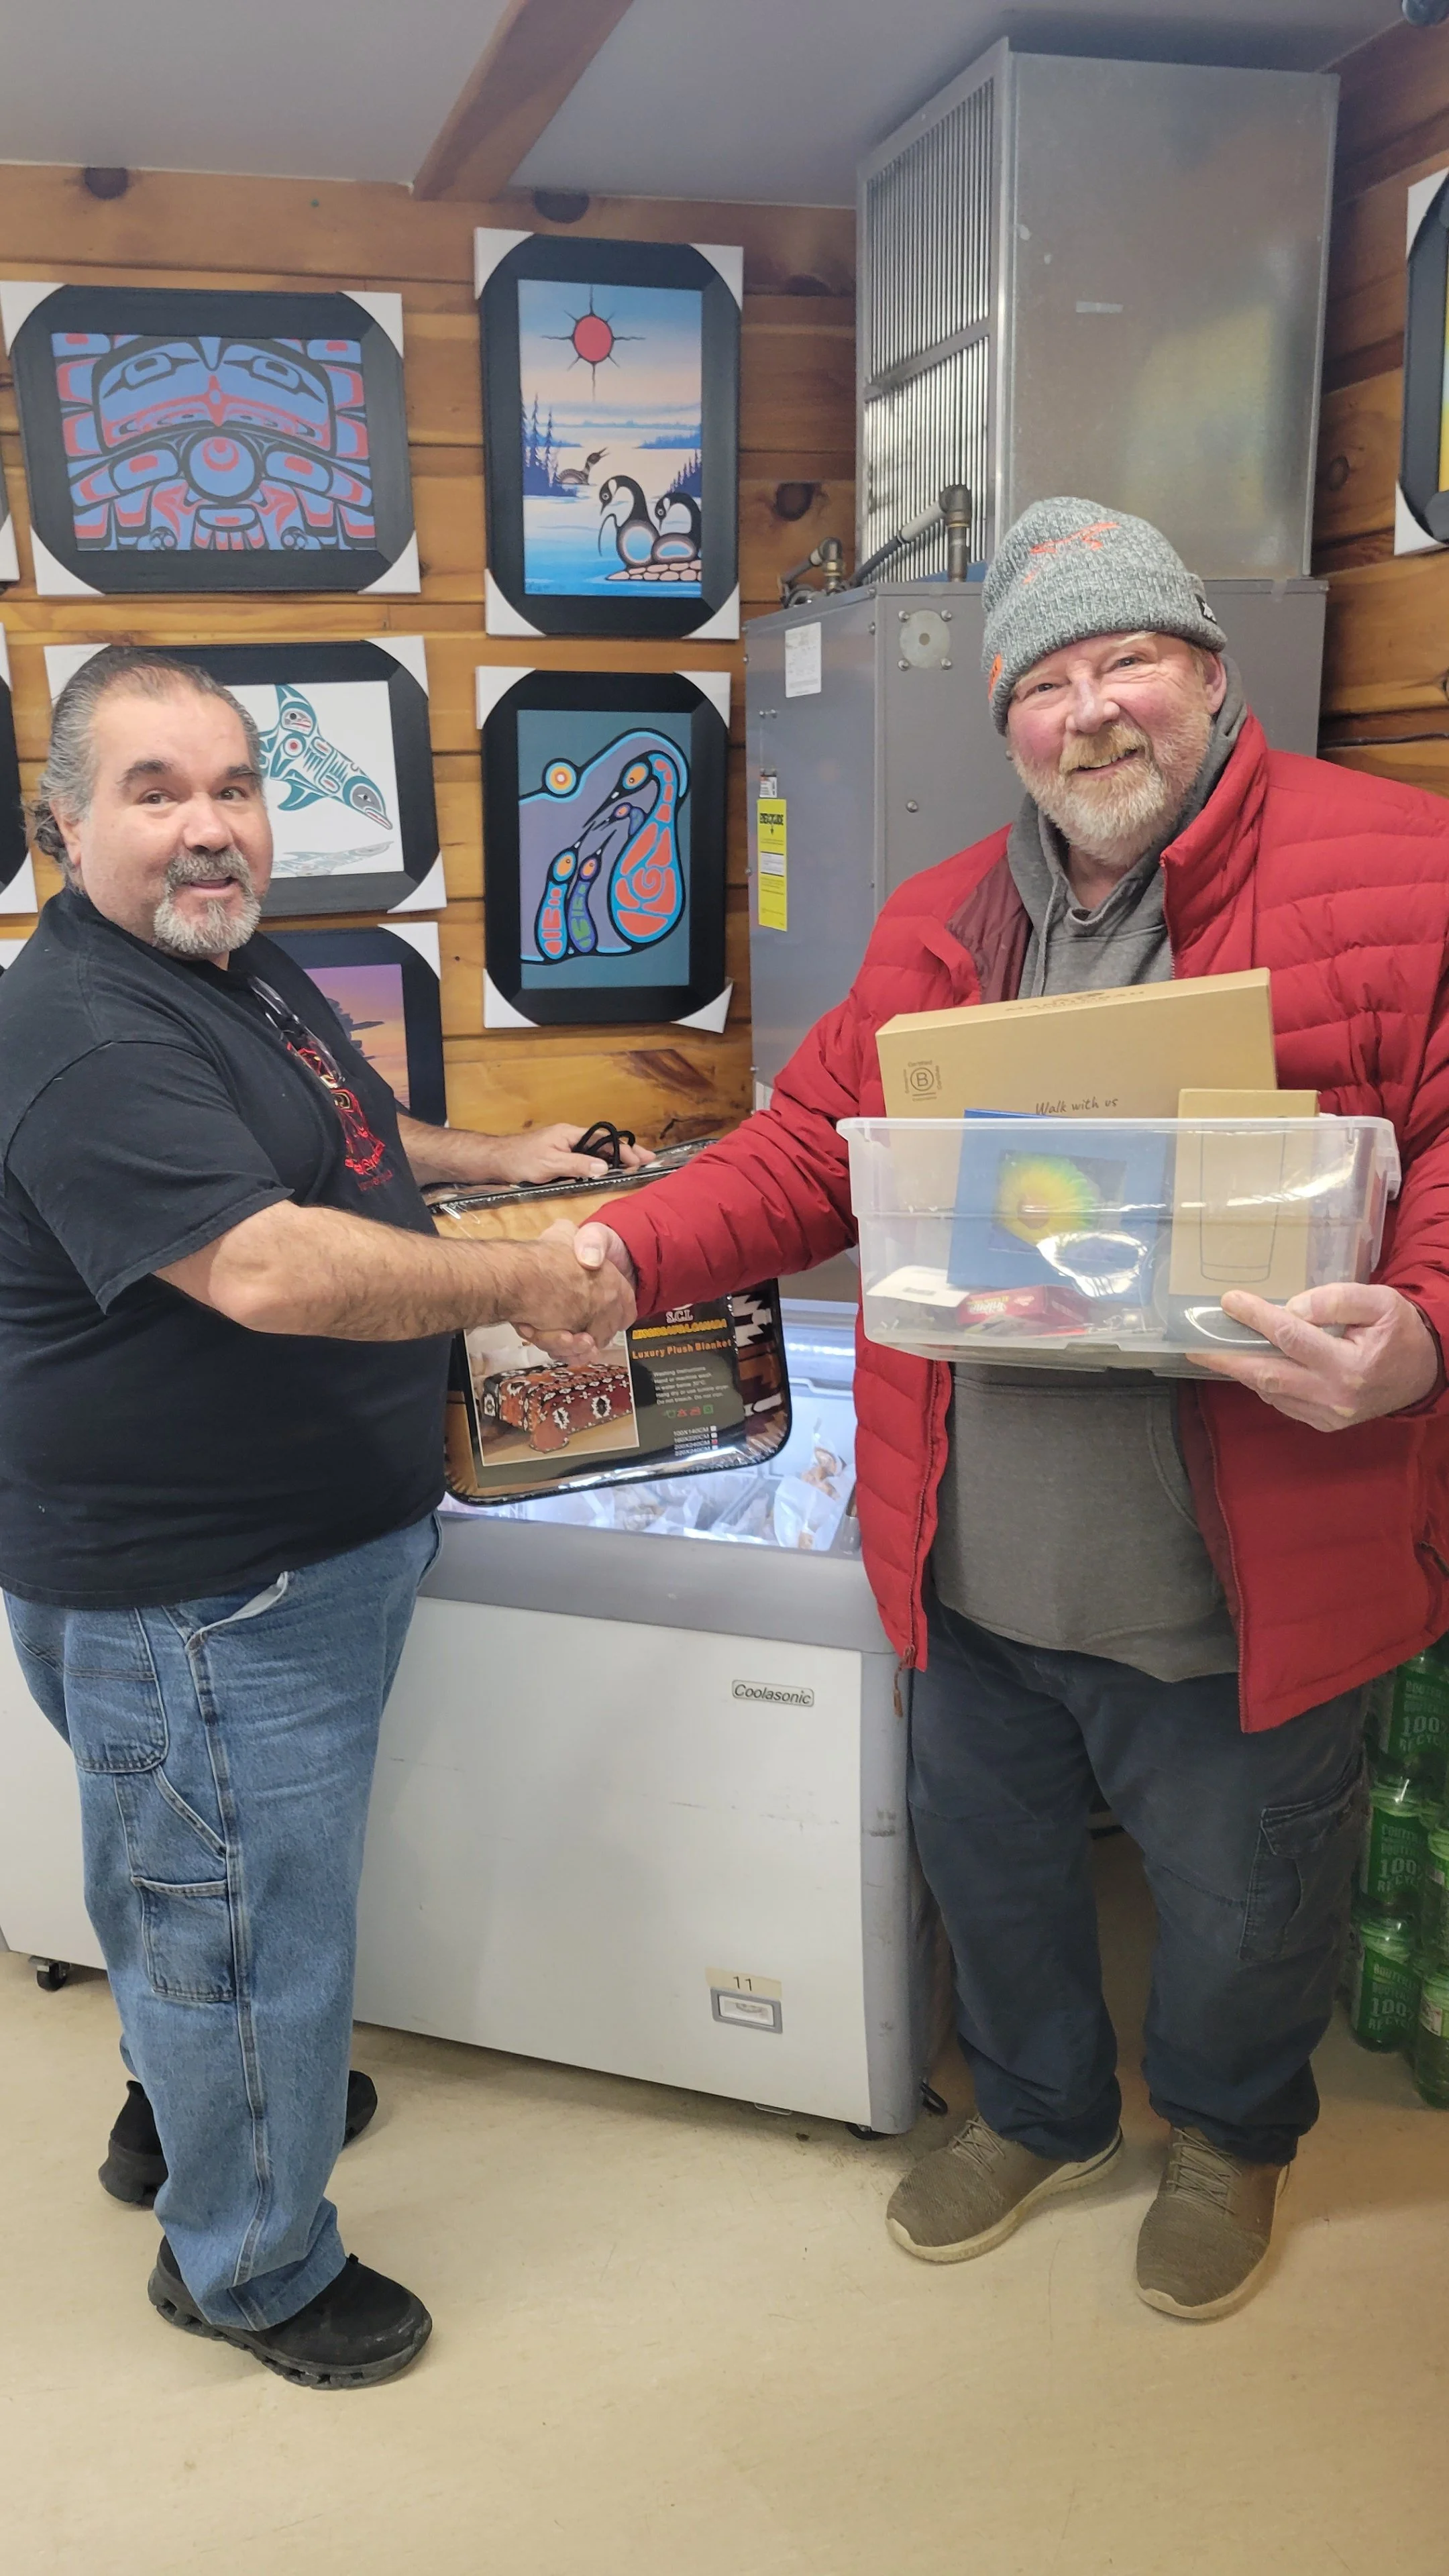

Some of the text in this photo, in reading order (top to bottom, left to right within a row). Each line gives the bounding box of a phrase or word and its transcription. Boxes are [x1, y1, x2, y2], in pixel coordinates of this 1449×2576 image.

[916, 1072, 928, 1087] B
[1035, 1096, 1118, 1116] Walk with us
[632, 1339, 732, 1359] Luxury Plush Blanket
[735, 1684, 811, 1705] Coolasonic
[733, 1976, 752, 1991] 11
